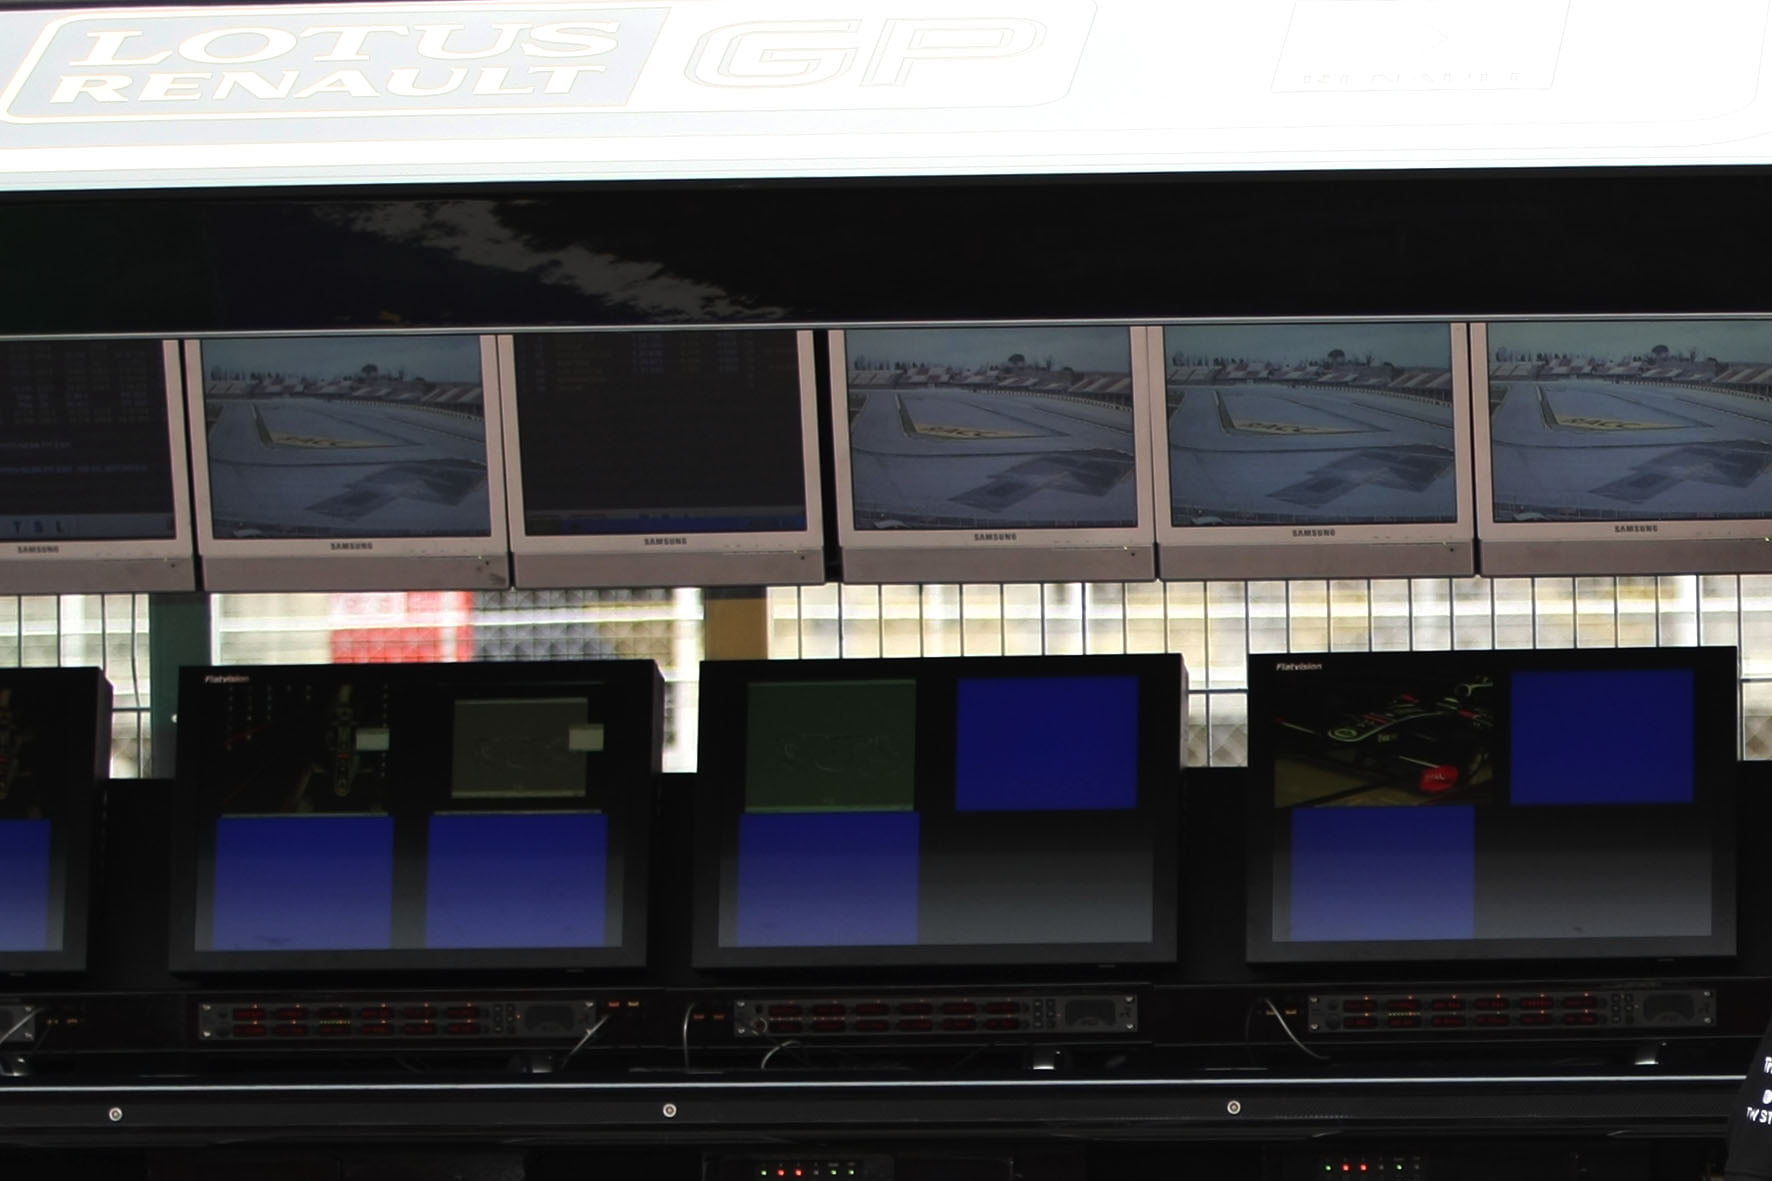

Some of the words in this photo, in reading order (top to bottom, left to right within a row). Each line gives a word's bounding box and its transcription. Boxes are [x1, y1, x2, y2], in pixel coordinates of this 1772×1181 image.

[69, 21, 621, 67] LOTUS
[683, 17, 1048, 88] GP
[48, 65, 607, 103] RENAULT
[1292, 529, 1335, 537] SAMSUNG
[1614, 525, 1658, 533] SAMSUNG
[644, 537, 687, 546] SAMSUNG
[974, 533, 1016, 541] SAMSUNG
[17, 545, 59, 554] SAMSUNG
[330, 542, 372, 551] SAMSUNG
[1275, 662, 1323, 671] Flatvision
